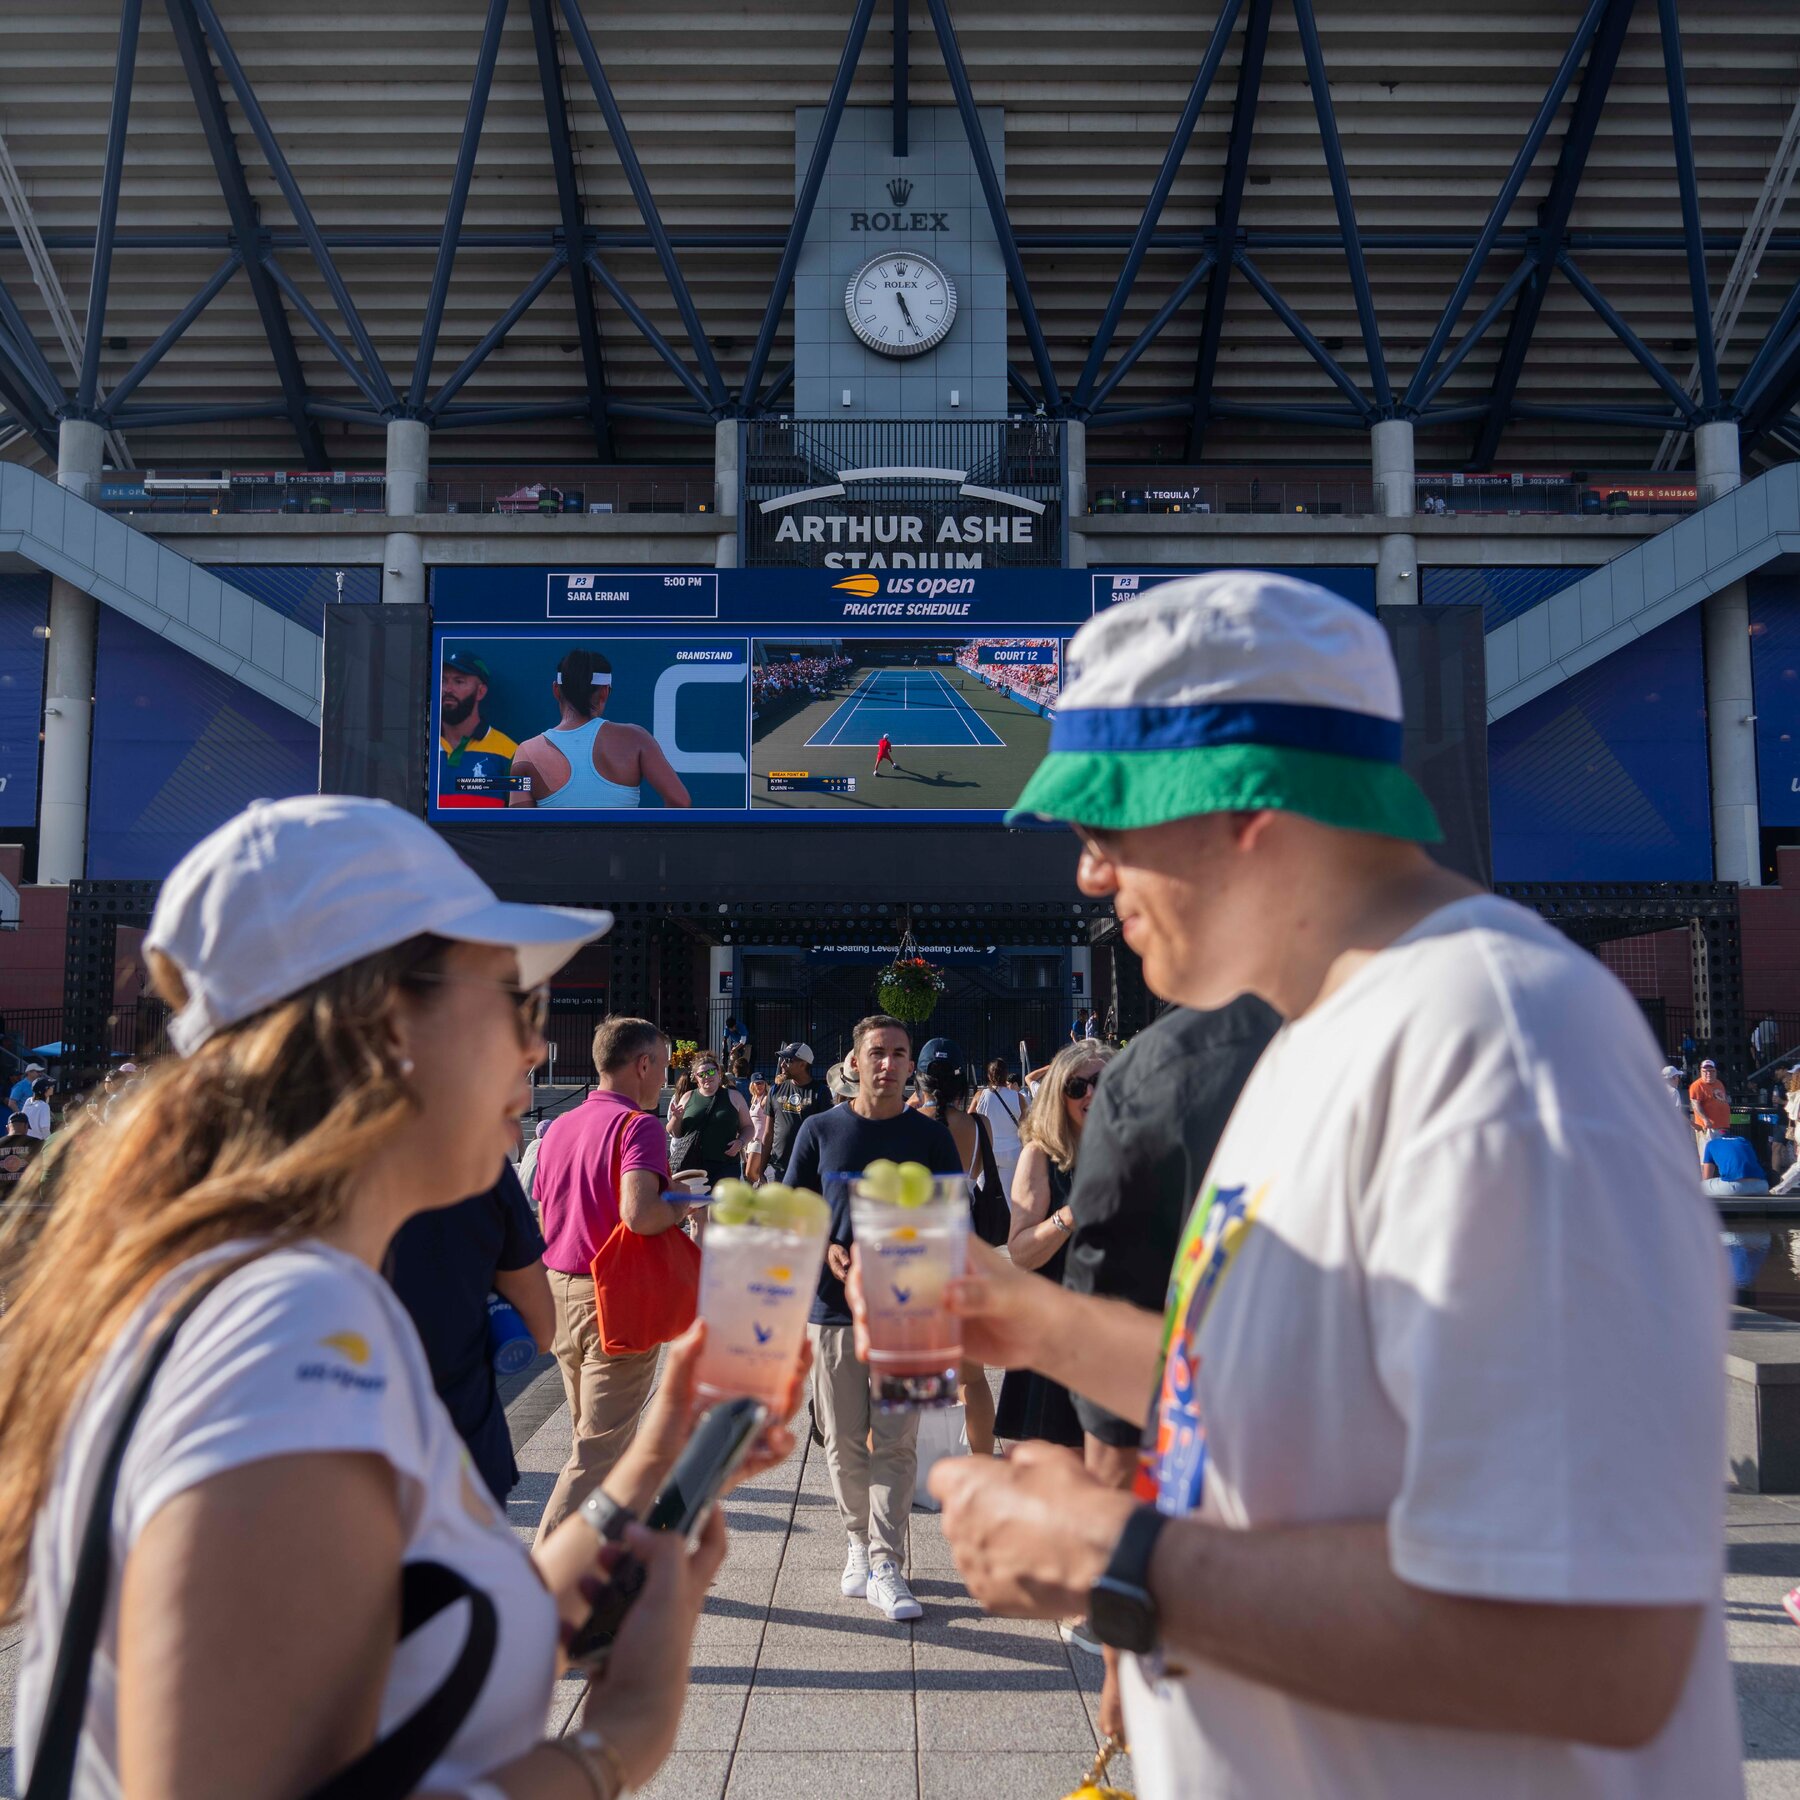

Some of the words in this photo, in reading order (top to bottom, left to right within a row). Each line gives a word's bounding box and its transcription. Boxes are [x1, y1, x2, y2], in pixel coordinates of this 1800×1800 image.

[850, 212, 950, 232] ROLEX
[884, 281, 918, 289] ROLEX
[1152, 491, 1190, 499] TEQUILA
[774, 515, 924, 543] ARTHUR
[935, 515, 1033, 543] ASHE
[824, 552, 982, 569] STADIUM
[575, 577, 587, 586] P3
[663, 577, 686, 586] 5:00
[687, 577, 702, 586] PM
[1120, 578, 1132, 586] P3
[886, 577, 916, 594] us
[916, 576, 975, 599] open
[567, 591, 593, 601] SARA
[594, 591, 630, 601] ERRANI
[1111, 592, 1137, 602] SARA
[842, 603, 903, 616] PRACTICE
[906, 603, 971, 616] SCHEDULE
[676, 651, 733, 660] GRANDSTAND
[994, 651, 1025, 661] COURT
[1027, 651, 1038, 661] 12
[836, 945, 869, 954] Seating
[918, 945, 951, 954] Seating
[488, 1303, 512, 1317] pen
